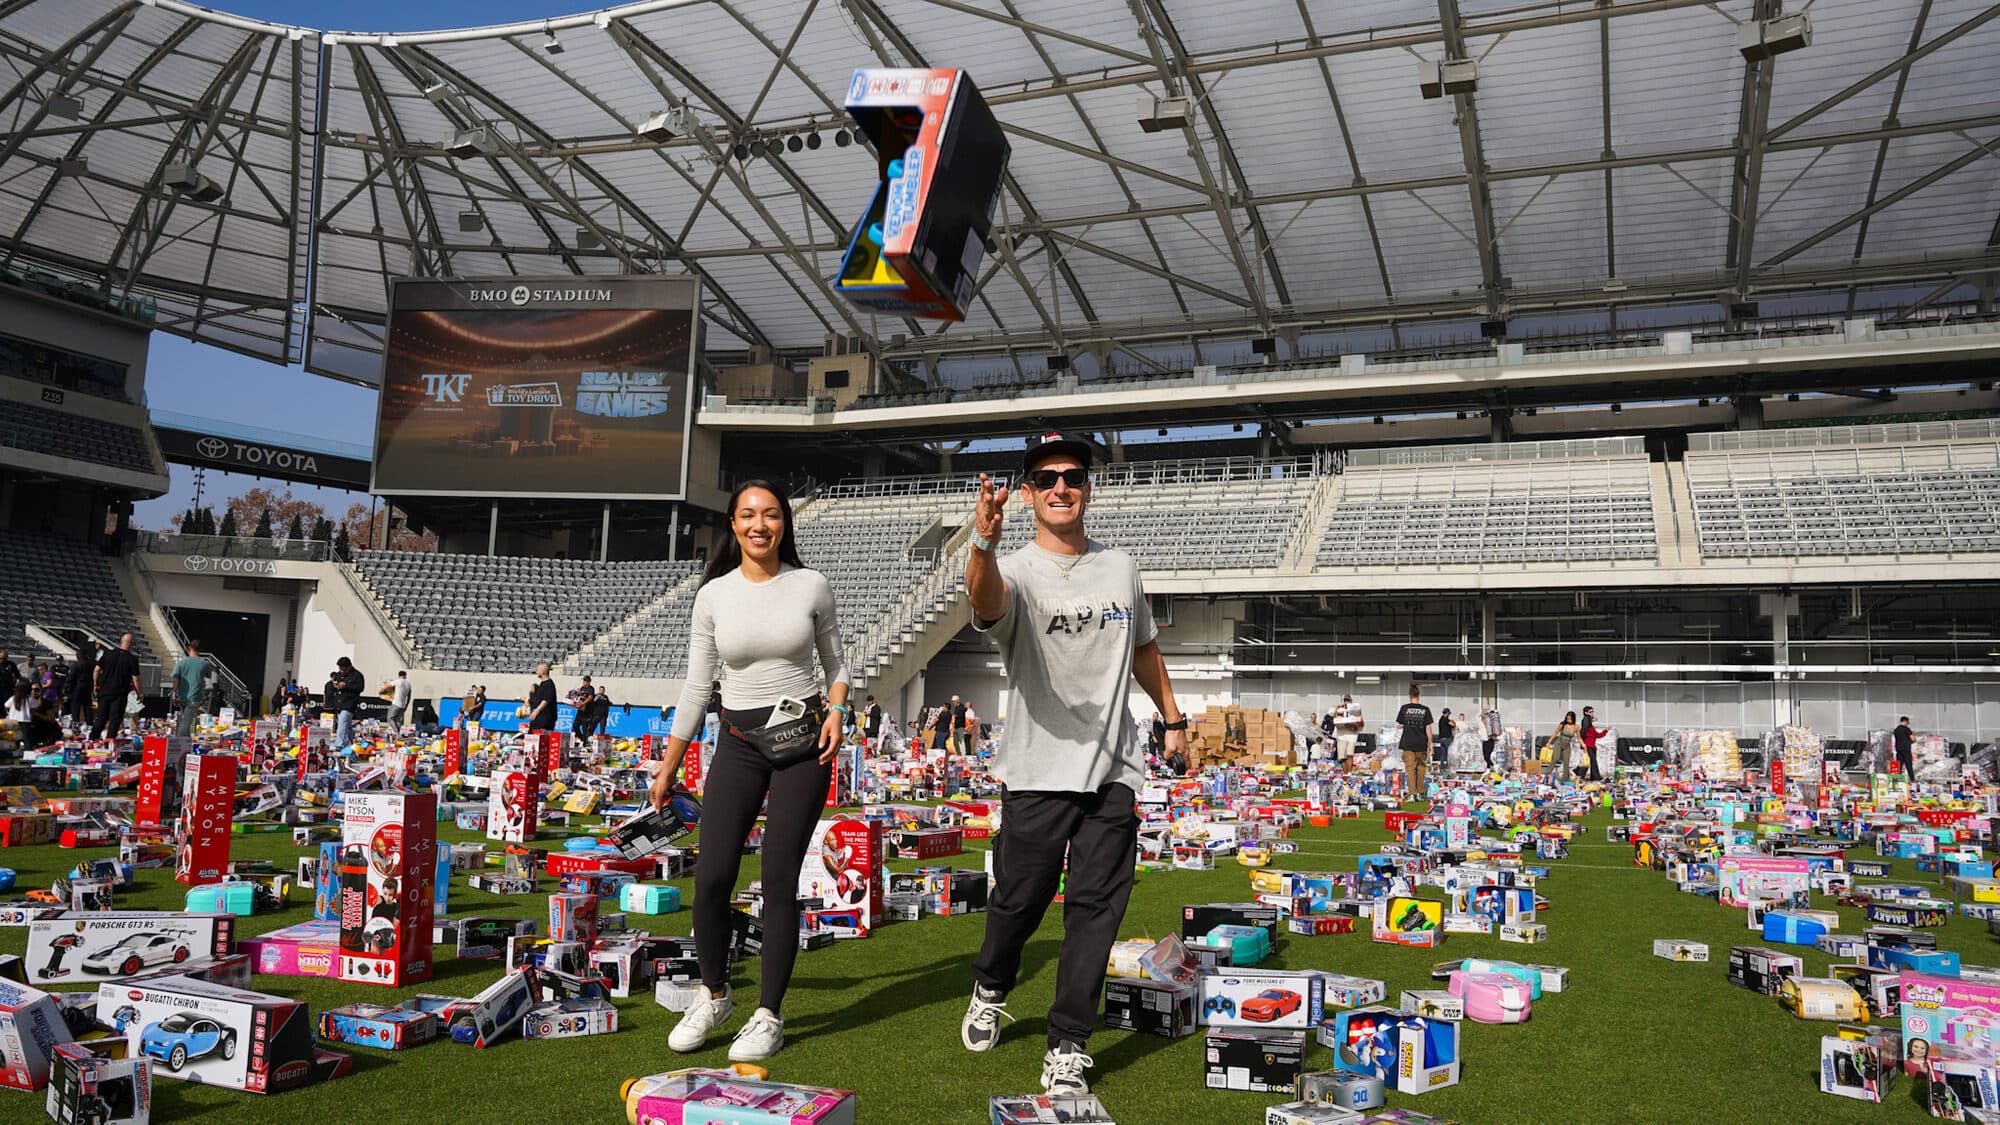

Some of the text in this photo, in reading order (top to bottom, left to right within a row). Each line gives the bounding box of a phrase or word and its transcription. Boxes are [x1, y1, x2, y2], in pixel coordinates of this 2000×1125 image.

[902, 149, 920, 223] TUMBLER
[469, 289, 613, 302] BMO STADIUM
[581, 371, 668, 385] REALITY
[421, 373, 473, 403] TKF
[43, 391, 62, 403] 235
[507, 395, 557, 403] TOY DRIVE
[576, 392, 668, 418] GAMES
[233, 443, 319, 473] TOYOTA
[211, 558, 278, 574] TOYOTA
[774, 724, 809, 743] GUCCI
[142, 749, 155, 805] TYSON
[151, 759, 161, 795] MIKE
[200, 772, 218, 847] TYSON
[215, 785, 228, 834] MIKE
[347, 797, 368, 806] MIKE
[347, 806, 375, 816] TYSON
[924, 845, 951, 854] TYSON
[408, 820, 420, 929] TYSON
[419, 838, 430, 908] MIKE
[342, 887, 353, 930] TYSON
[352, 891, 364, 928] MIKE
[89, 921, 127, 929] PORSCHE
[1874, 911, 1909, 924] GALAXY
[298, 953, 331, 967] QUEEN
[144, 992, 173, 1006] BUGATTI
[173, 997, 200, 1009] CHIRON
[1404, 1042, 1413, 1079] SONIC
[275, 1066, 309, 1082] BUGATTI
[1352, 1090, 1368, 1104] DC
[1268, 1113, 1288, 1123] STAR
